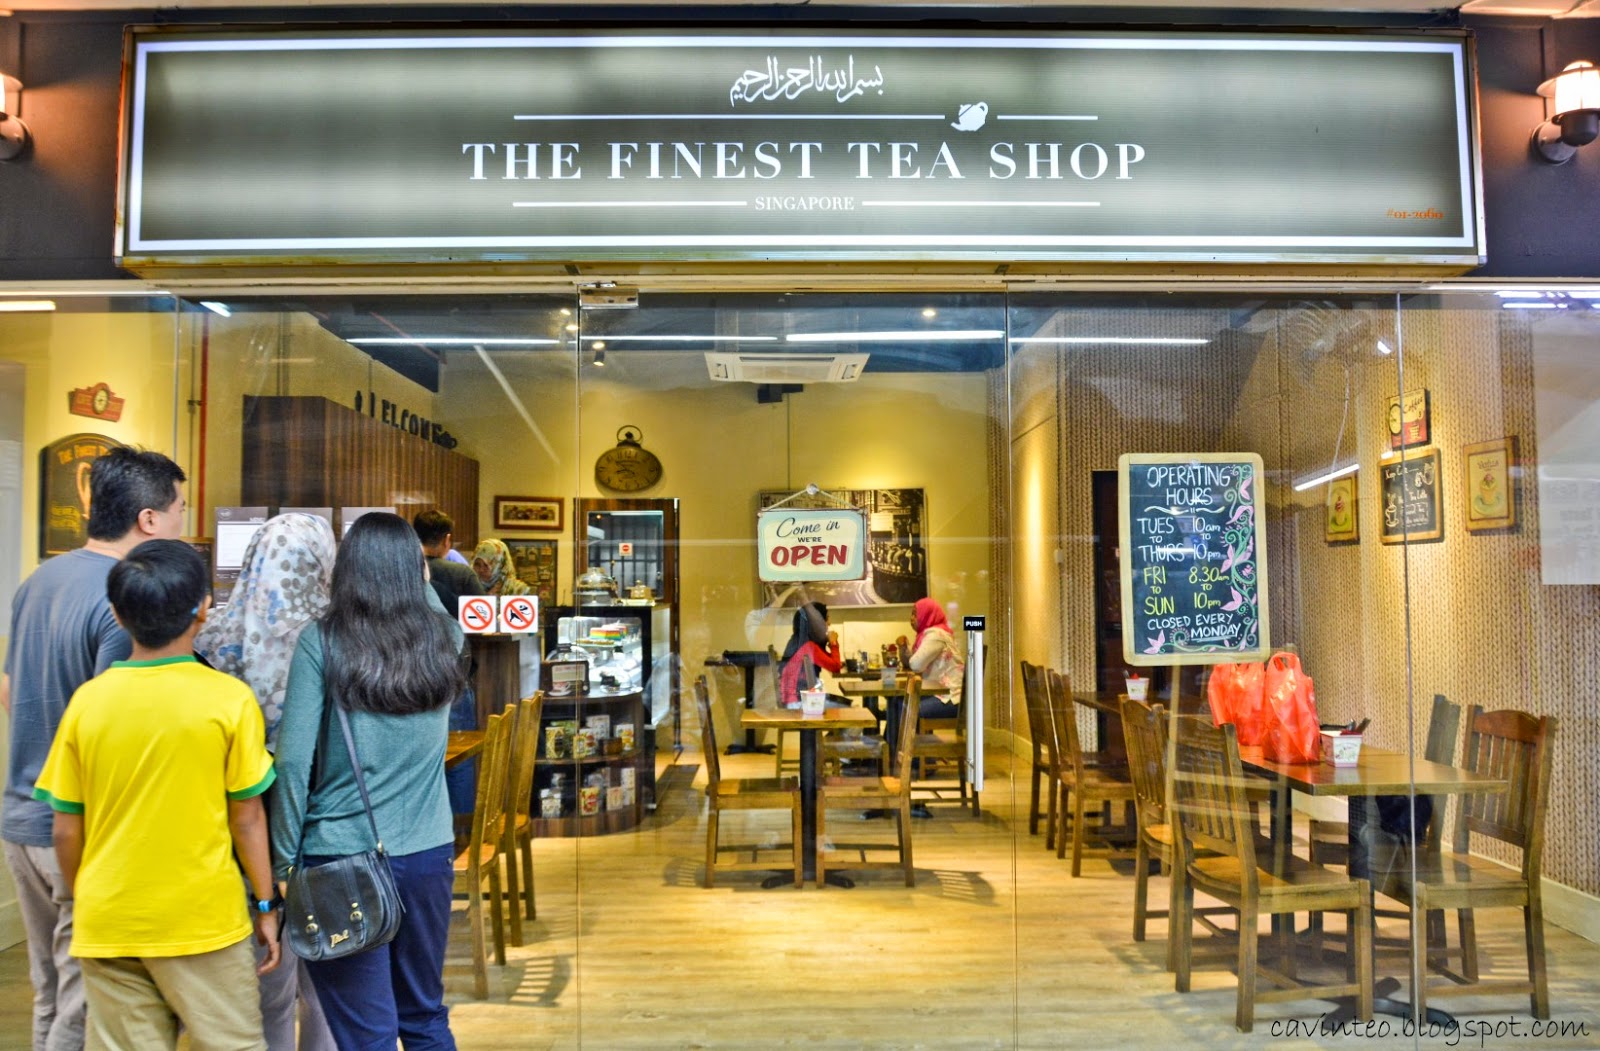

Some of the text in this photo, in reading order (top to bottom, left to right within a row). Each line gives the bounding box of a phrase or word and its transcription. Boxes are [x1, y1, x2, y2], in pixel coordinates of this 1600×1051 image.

[462, 141, 1146, 180] THE FINEST TEA SHOP
[754, 196, 855, 211] SINGAPORE
[1146, 465, 1231, 488] OPERATING
[1166, 487, 1214, 506] HOURS
[776, 517, 840, 538] Come in
[1137, 517, 1221, 535] TUES 10am
[1149, 533, 1212, 544] TO TO
[770, 544, 848, 567] OPEN
[1138, 543, 1222, 563] THURS 10pm
[1143, 565, 1230, 586] FRI 8.30am
[1150, 583, 1213, 594] TO TO
[1143, 592, 1222, 616] SUN 10pm
[1147, 613, 1234, 631] CLOSED EVERY
[1190, 623, 1242, 639] MONDAY
